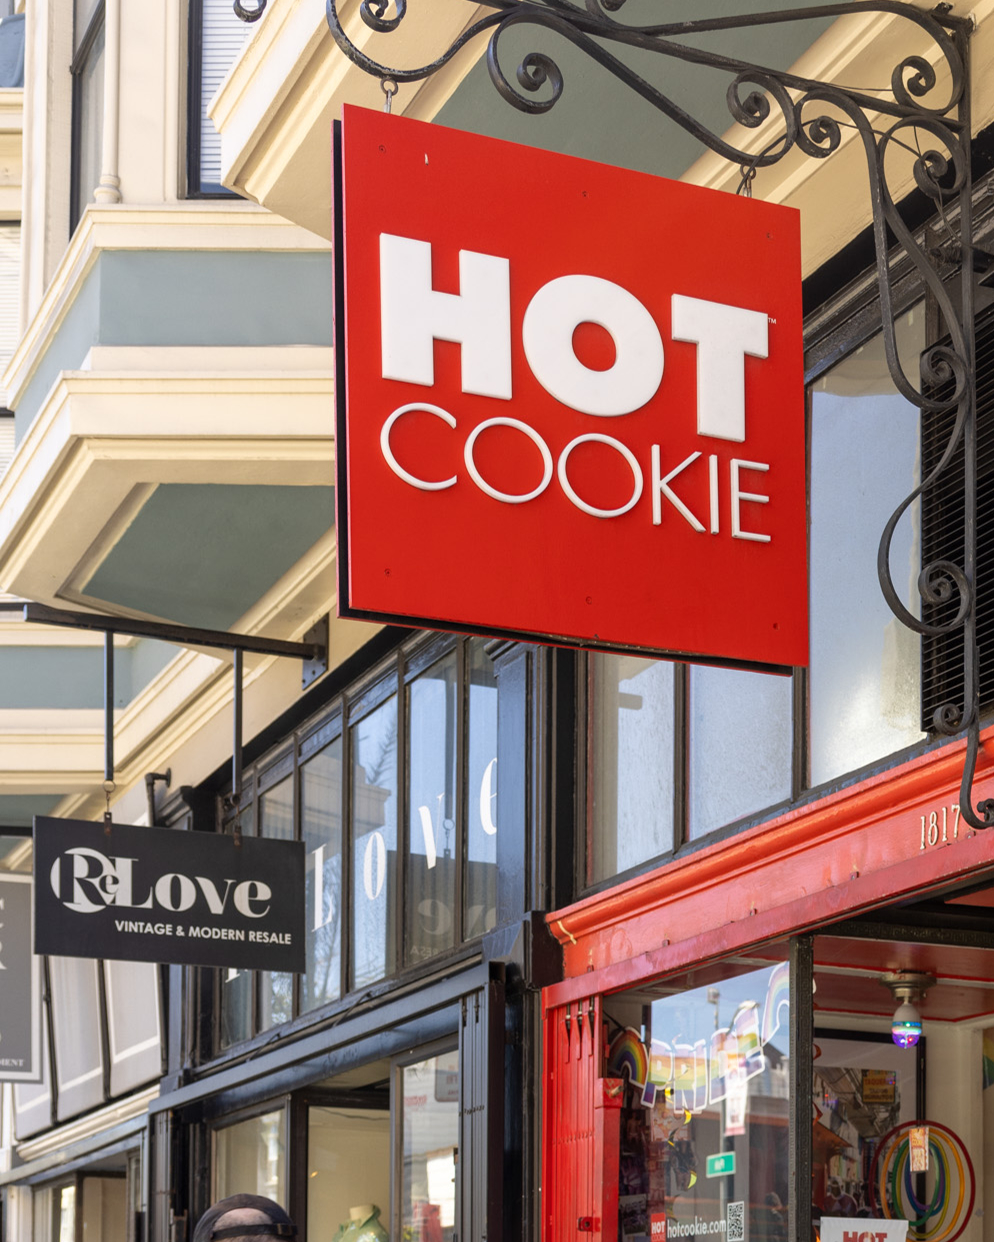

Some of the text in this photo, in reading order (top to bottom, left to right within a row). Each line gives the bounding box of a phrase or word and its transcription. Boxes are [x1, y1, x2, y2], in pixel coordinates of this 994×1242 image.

[379, 232, 769, 443] HOT
[380, 402, 771, 543] COOKIE
[920, 804, 961, 850] 1817
[50, 847, 272, 918] ReLove
[115, 920, 292, 945] VINTAGE & MODERN RESALE
[651, 1220, 666, 1235] HOT
[667, 1215, 726, 1239] hotcookie.com
